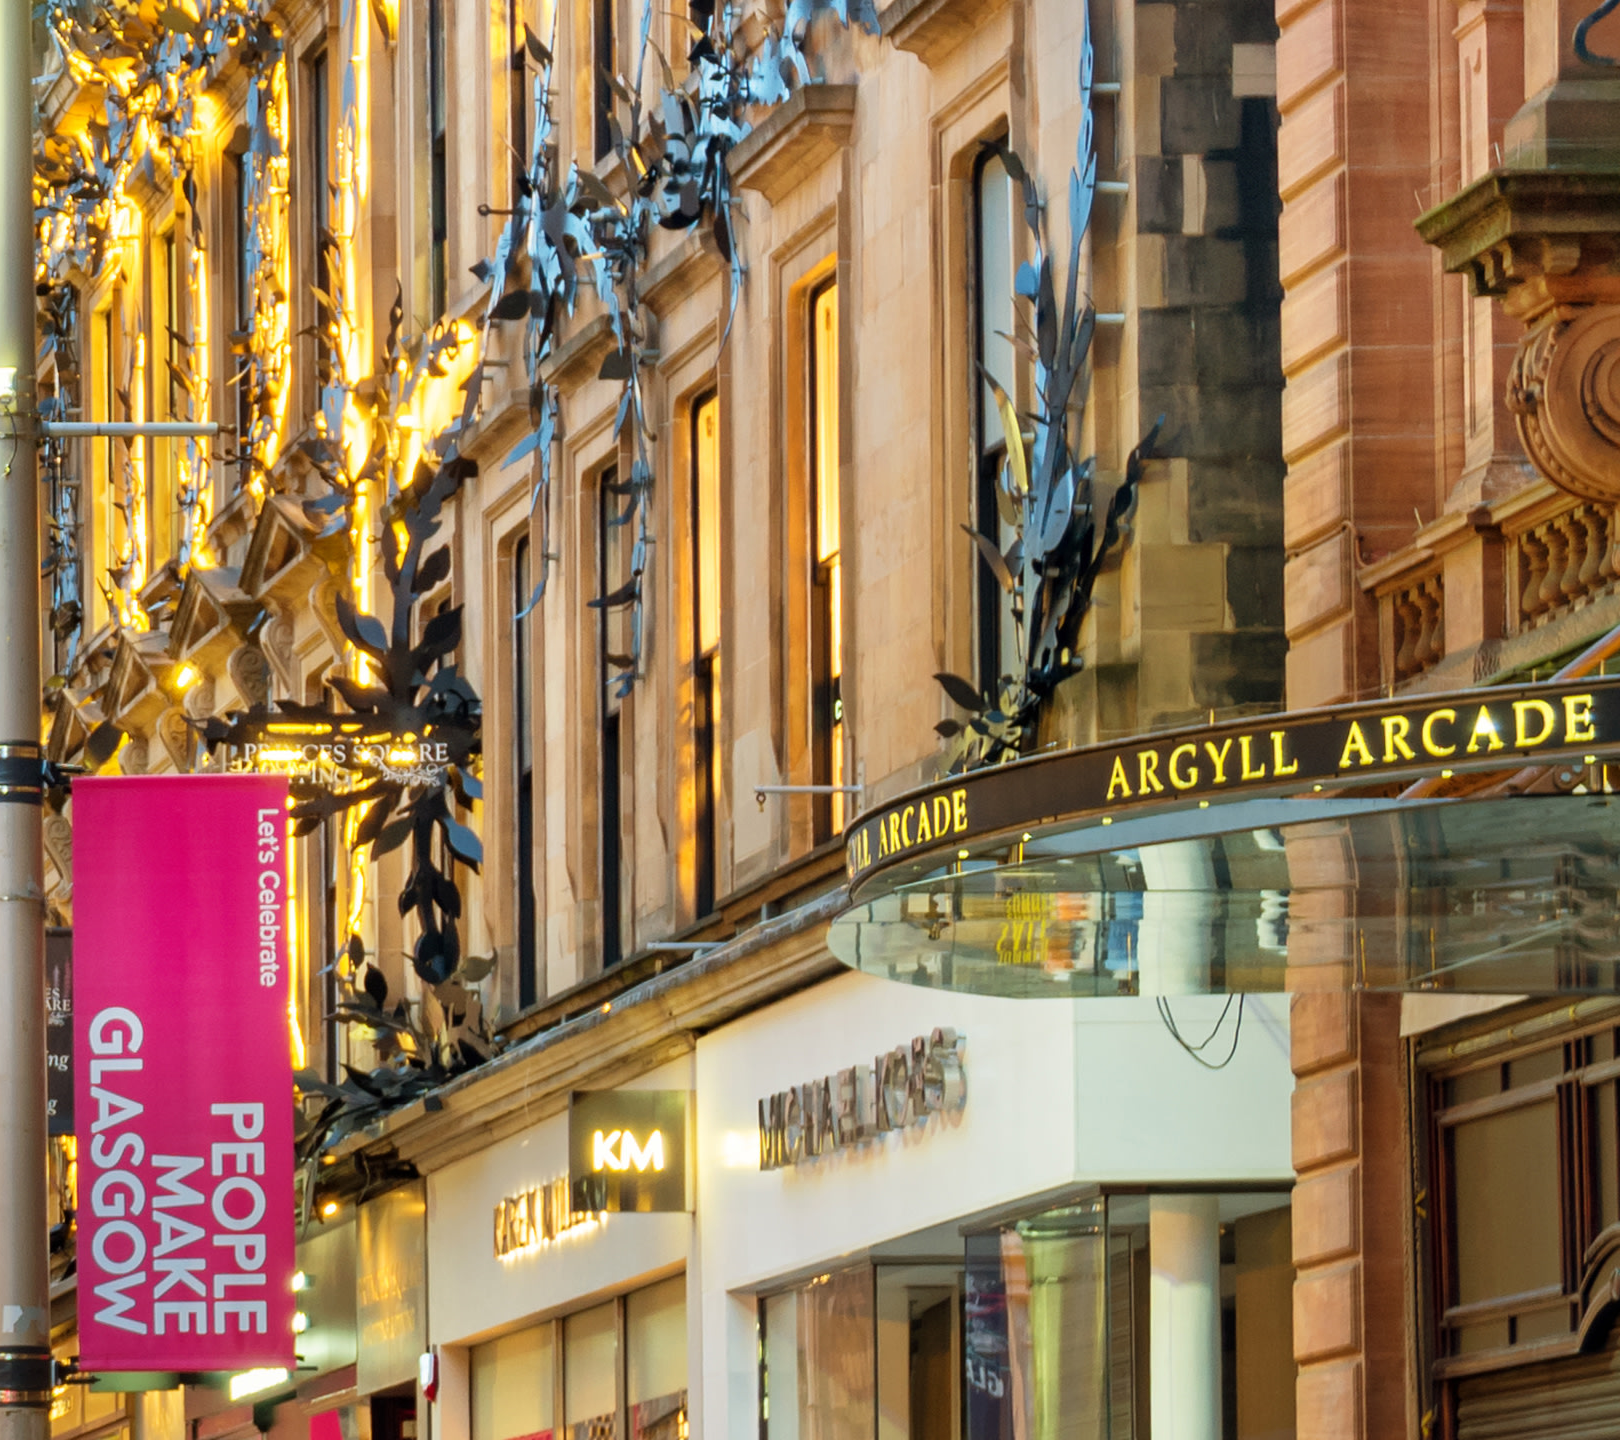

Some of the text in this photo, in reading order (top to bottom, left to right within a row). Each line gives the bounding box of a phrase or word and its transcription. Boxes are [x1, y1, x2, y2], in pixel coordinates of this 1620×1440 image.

[878, 788, 968, 860] ARCADE
[1106, 694, 1596, 802] ARGYLL ARCADE
[257, 807, 281, 987] Let's Celebrate
[88, 1006, 148, 1336] GLASGOW
[210, 1102, 267, 1335] PEOPLE
[592, 1129, 665, 1172] KM
[151, 1153, 208, 1336] MAKE
